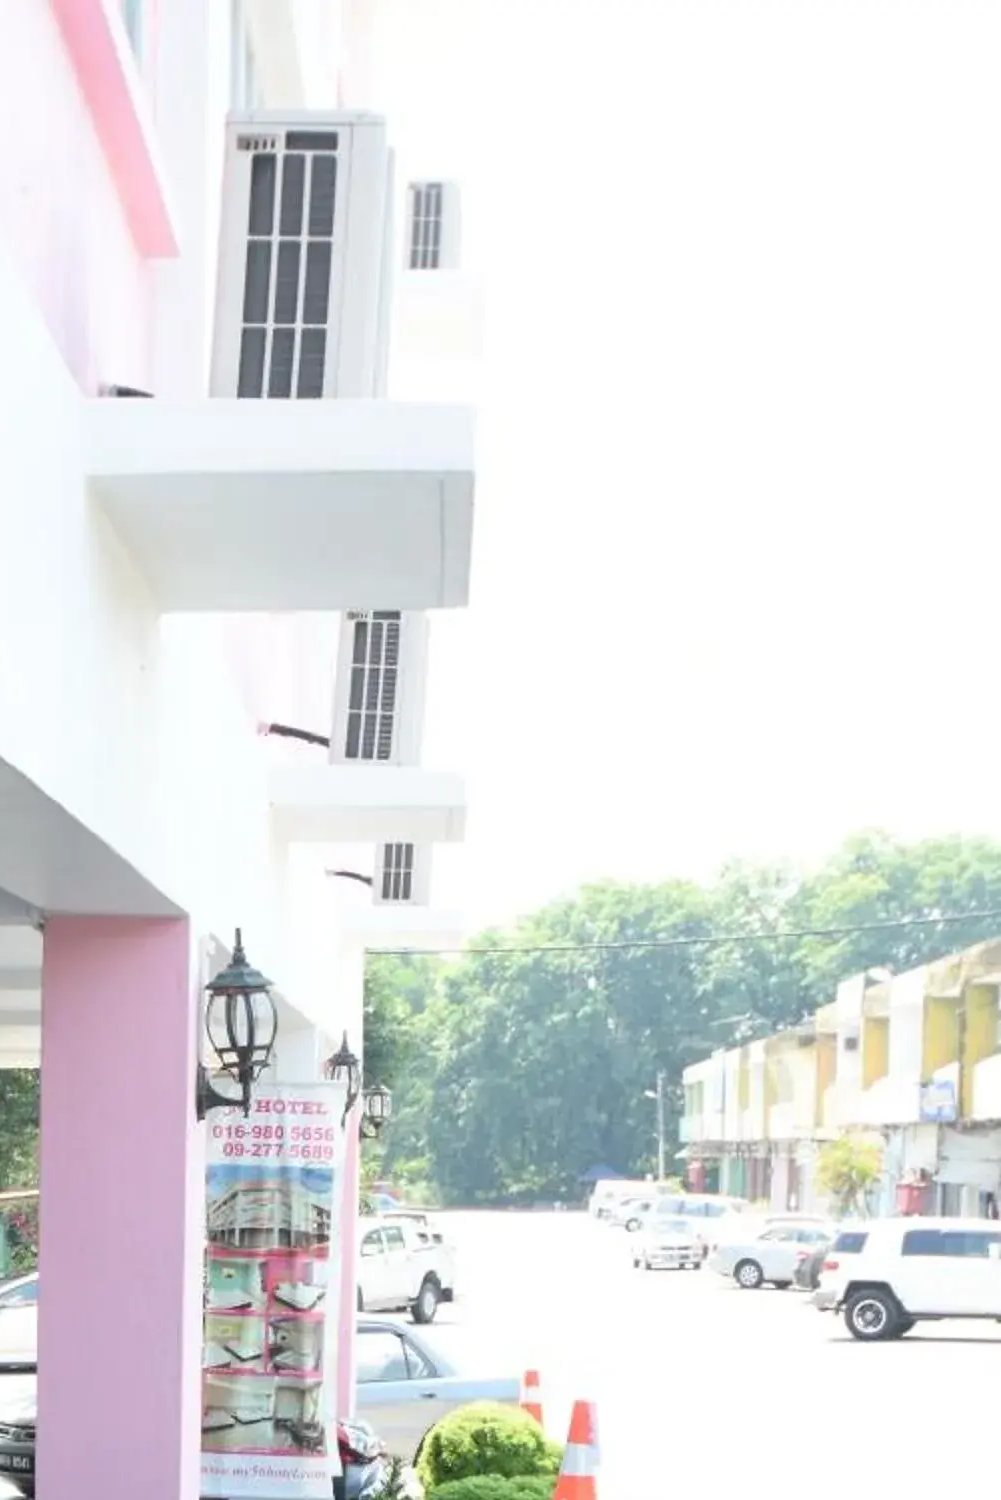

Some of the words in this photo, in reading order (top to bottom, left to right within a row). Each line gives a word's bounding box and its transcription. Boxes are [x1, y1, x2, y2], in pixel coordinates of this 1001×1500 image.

[254, 1099, 328, 1116] HOTEL
[212, 1125, 284, 1140] 016-980
[223, 1143, 284, 1158] 09-277
